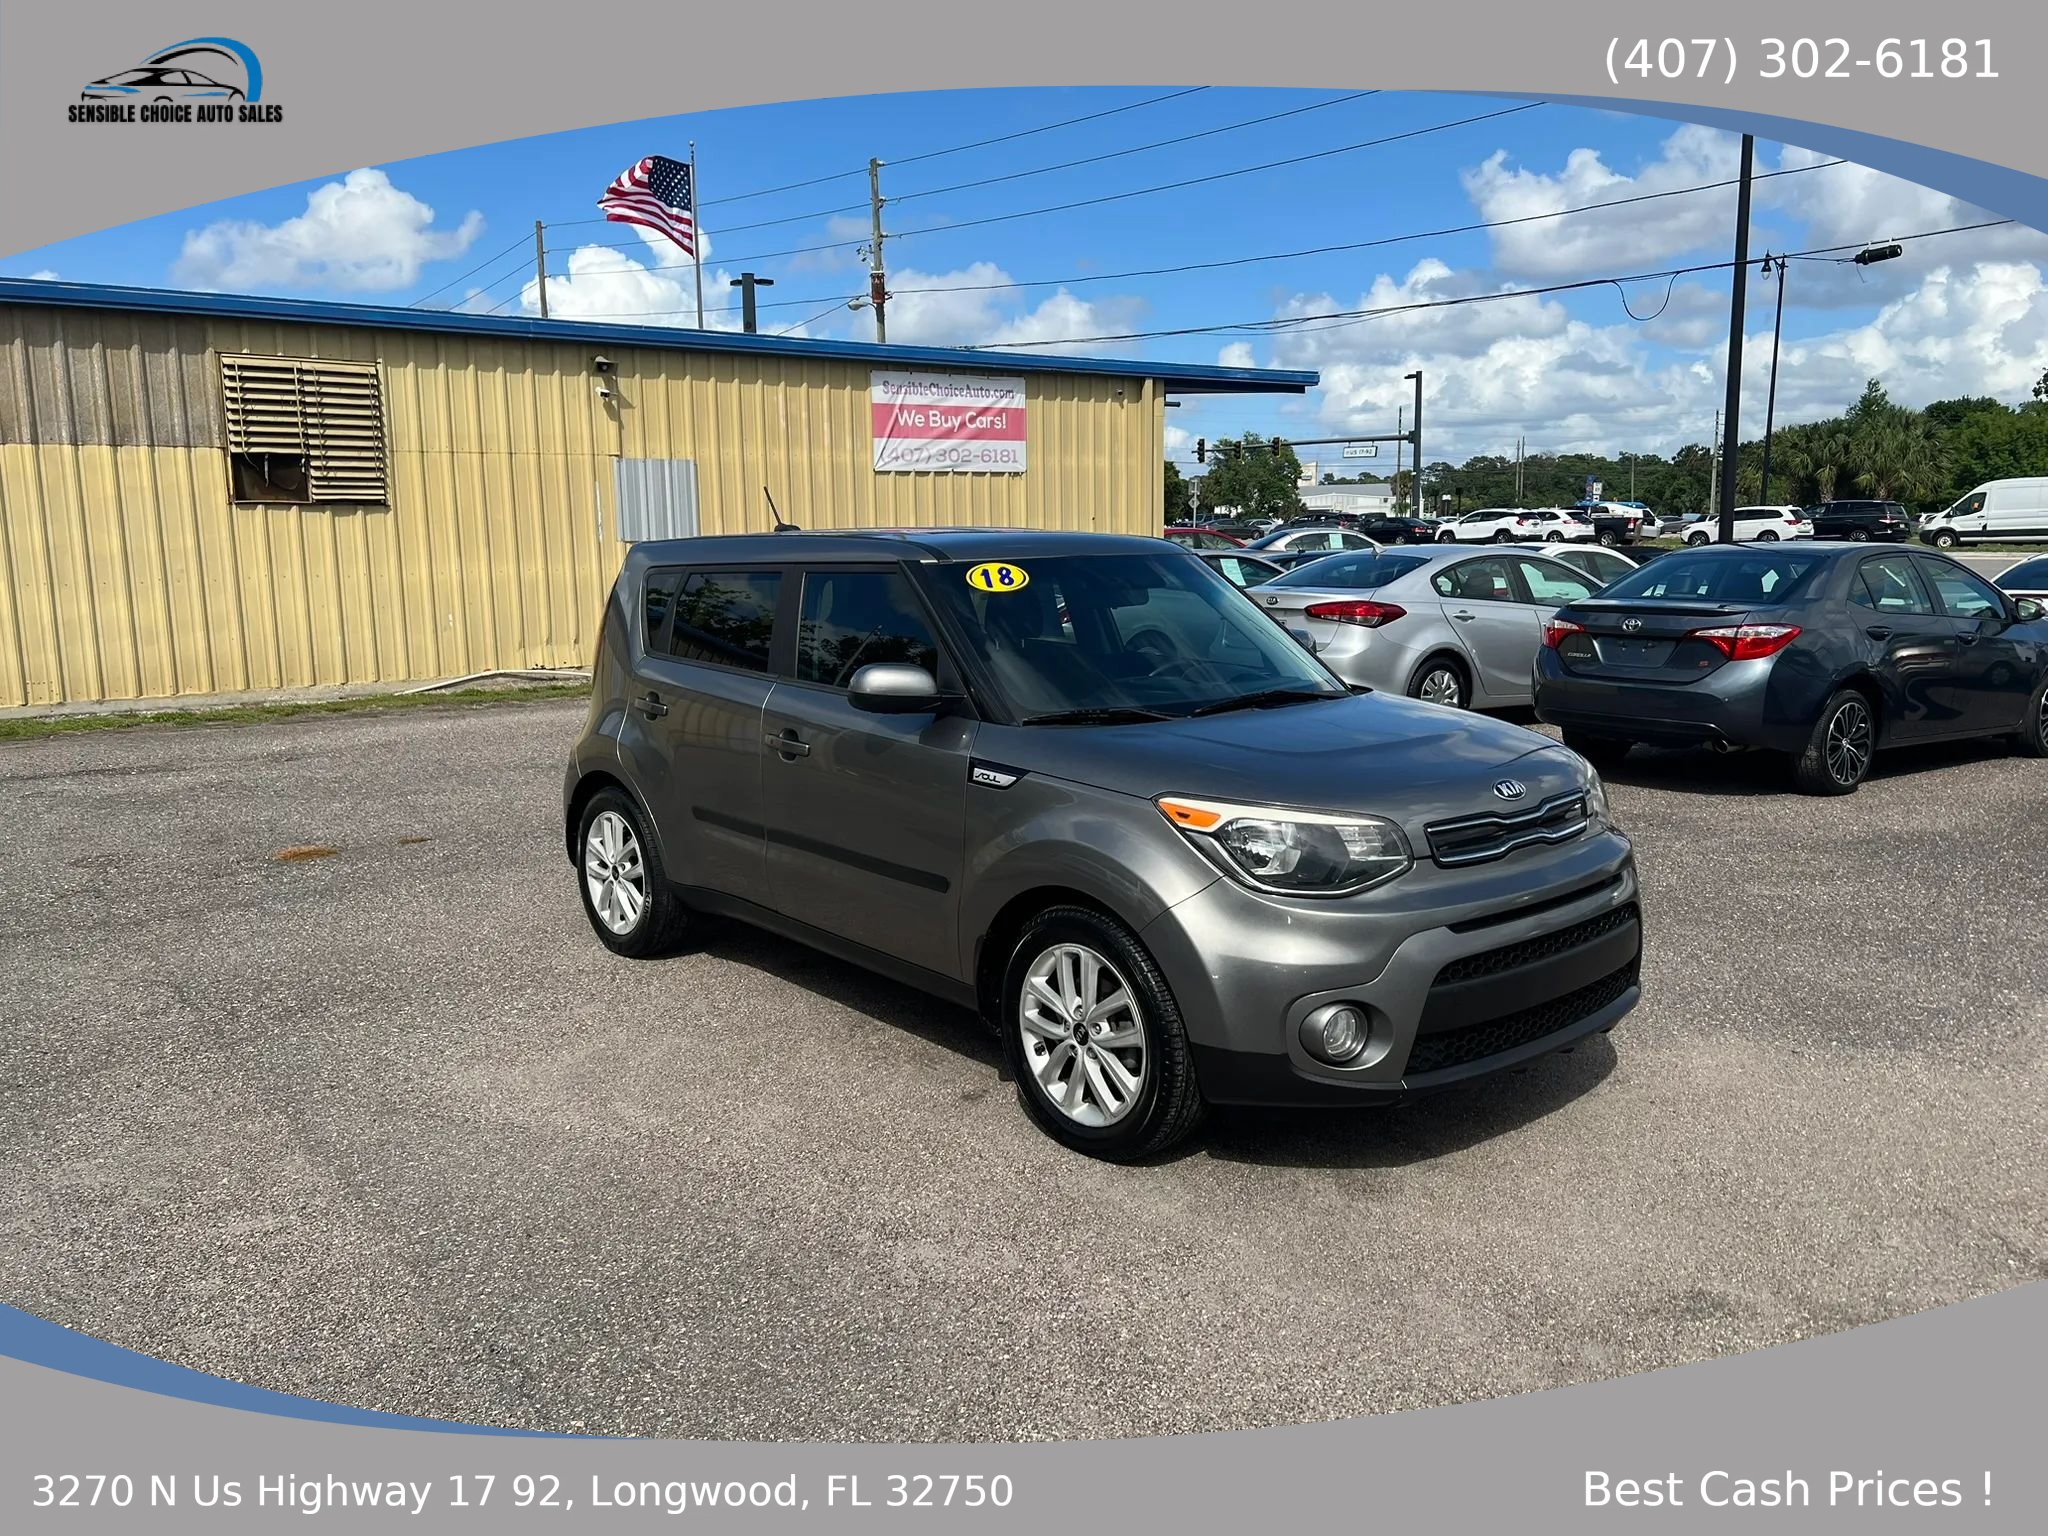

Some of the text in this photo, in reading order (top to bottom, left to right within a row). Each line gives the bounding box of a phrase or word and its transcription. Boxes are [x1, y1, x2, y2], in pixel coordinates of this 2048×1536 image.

[882, 379, 1015, 400] SensibleChoiceAuto.com
[897, 409, 1007, 432] We Buy Cars!
[881, 447, 1018, 464] (407) 302-6181
[981, 566, 1015, 588] 18
[974, 772, 1001, 784] SOUL
[1496, 781, 1524, 797] KIA
